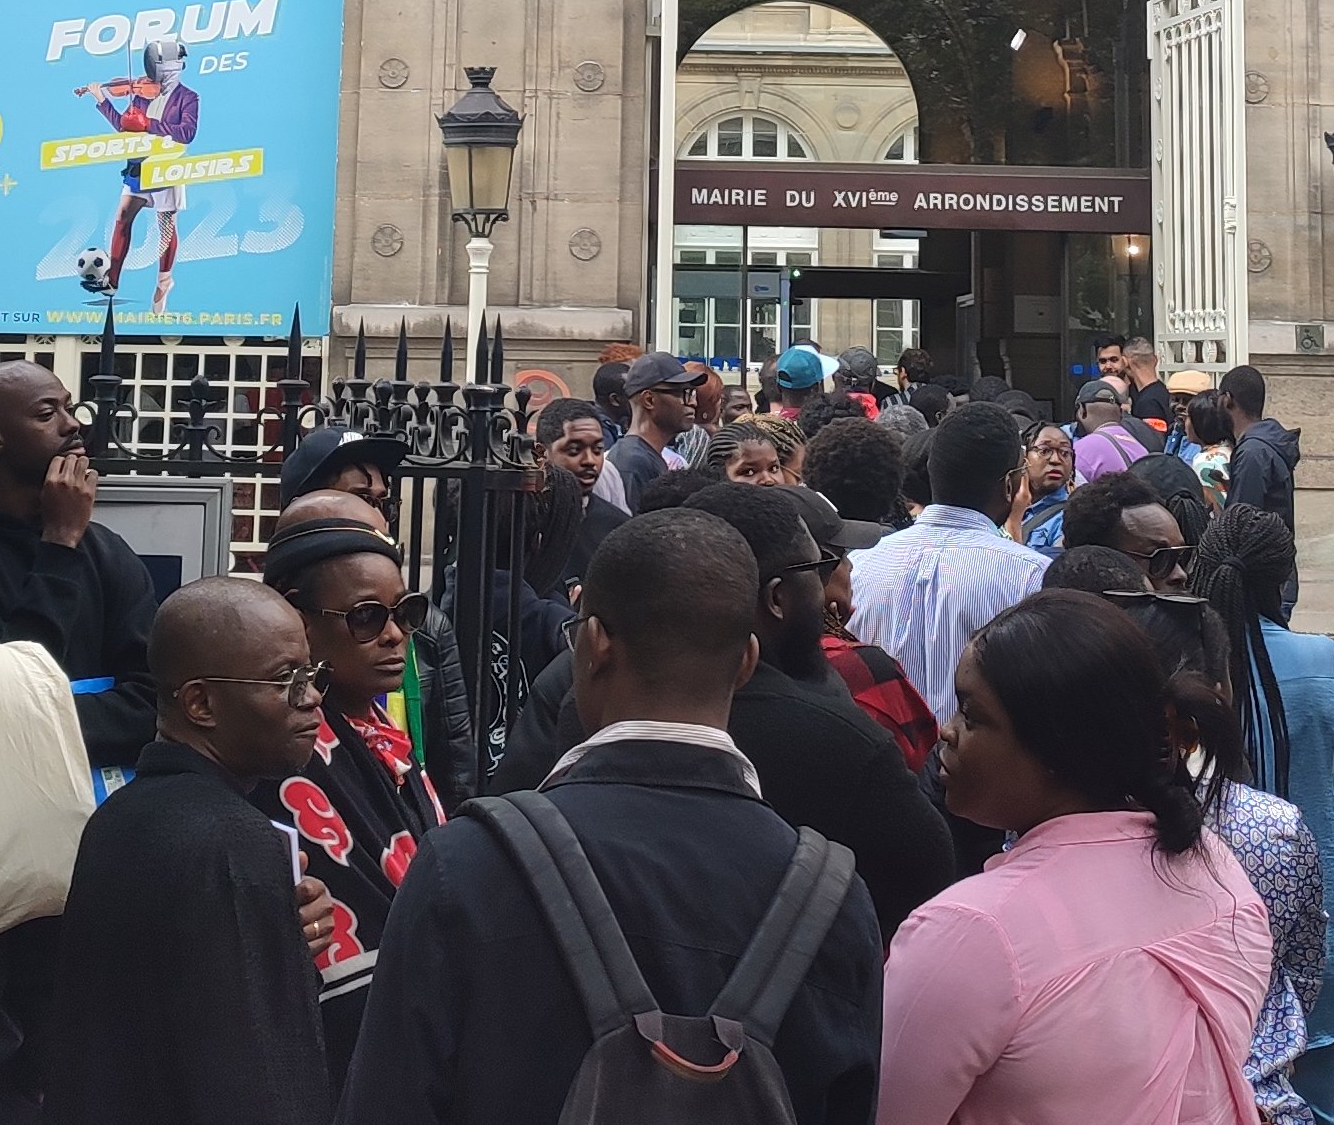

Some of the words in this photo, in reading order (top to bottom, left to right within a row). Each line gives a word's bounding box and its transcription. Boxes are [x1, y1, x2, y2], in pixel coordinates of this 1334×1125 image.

[199, 51, 250, 75] DES
[50, 133, 158, 164] SPORTS
[150, 154, 254, 185] LOISIRS
[691, 187, 767, 206] MAIRIE
[785, 190, 815, 207] DU
[913, 192, 1124, 214] ARRONDISSEMENT
[35, 178, 305, 282] 2023
[13, 312, 41, 323] SUR
